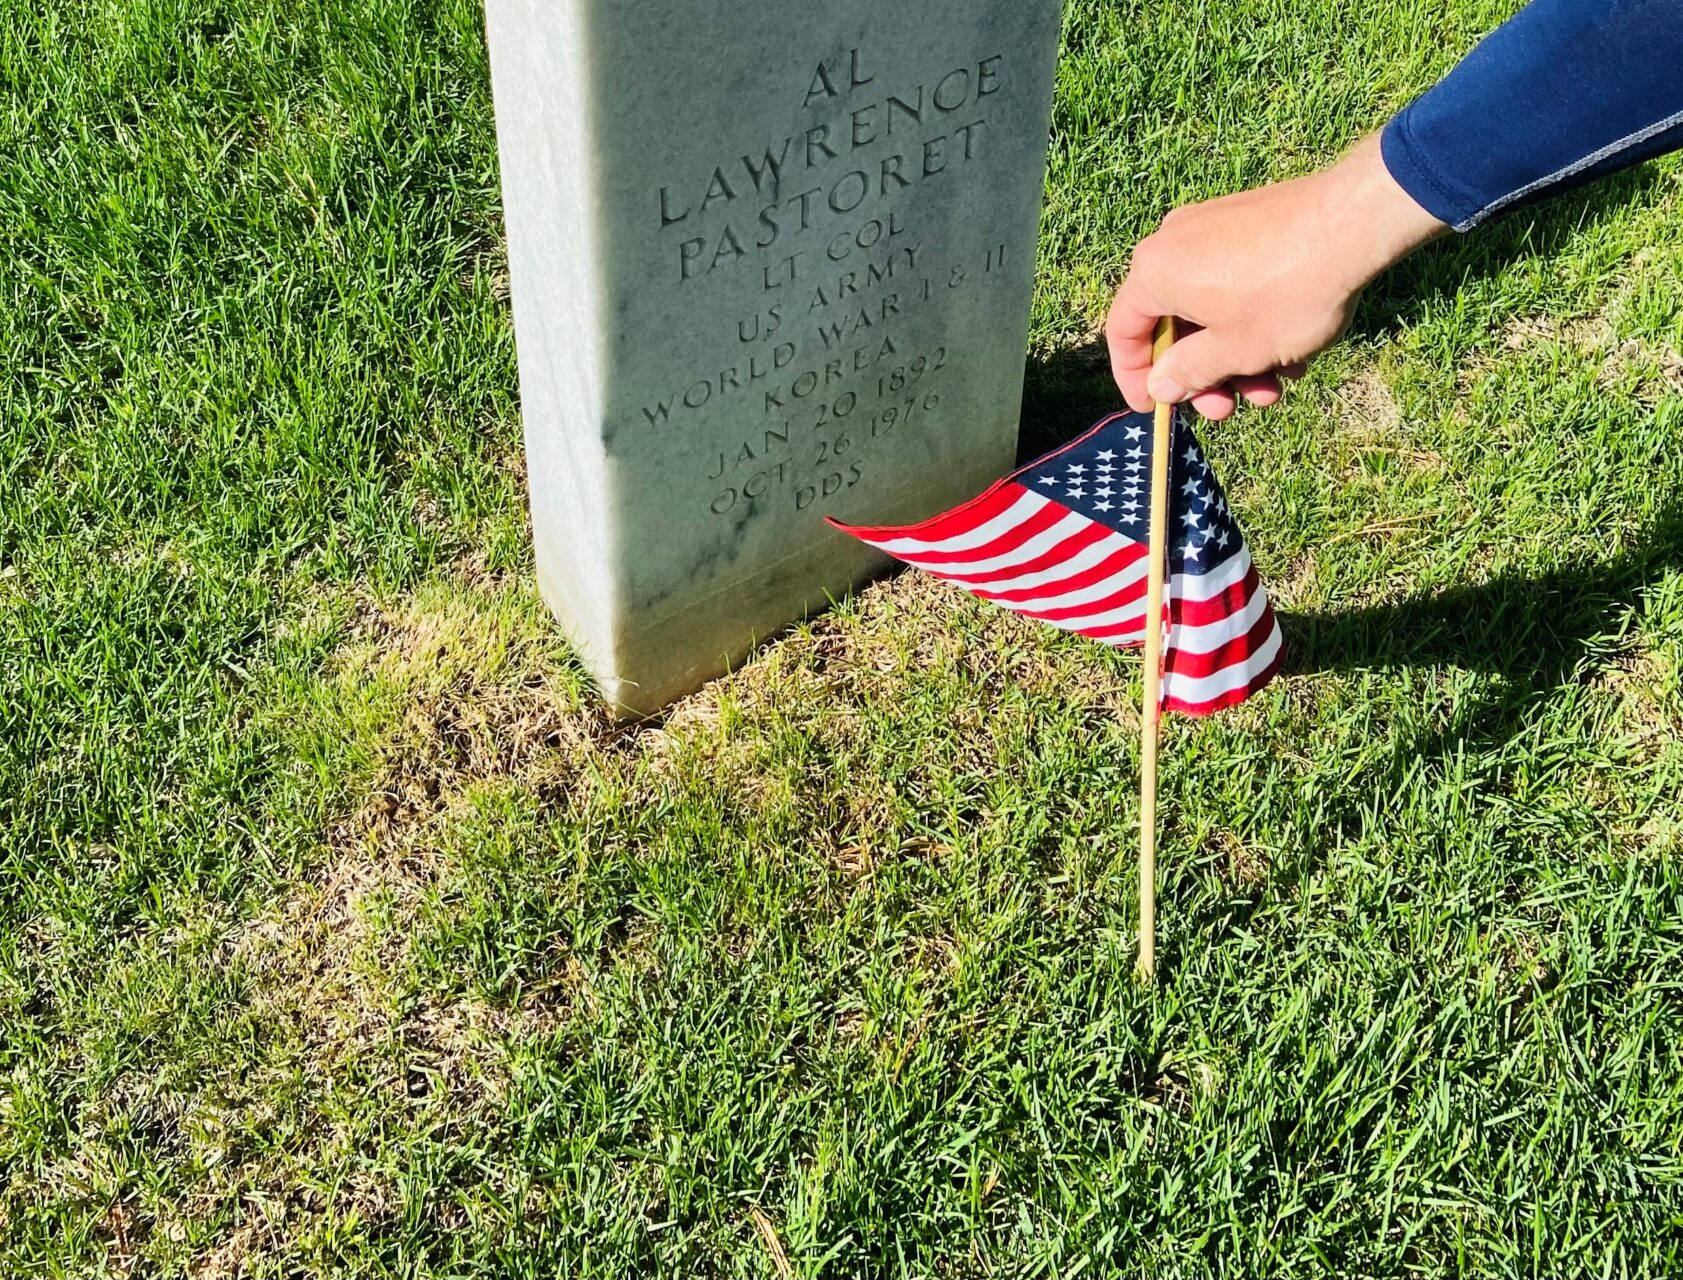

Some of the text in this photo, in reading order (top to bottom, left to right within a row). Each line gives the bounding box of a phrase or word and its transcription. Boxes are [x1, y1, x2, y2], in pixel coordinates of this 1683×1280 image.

[803, 47, 875, 110] AL
[658, 53, 1004, 230] LAWRENCE
[678, 120, 987, 283] PASTORET
[762, 212, 904, 293] LT COL
[640, 242, 1006, 429] WORLD WAR I & II
[737, 241, 922, 344] US ARMY
[707, 346, 949, 482] JAN 20 1892
[763, 334, 898, 415] KOREA
[709, 389, 941, 518] OCT 26 1976
[793, 458, 865, 514] DDS
